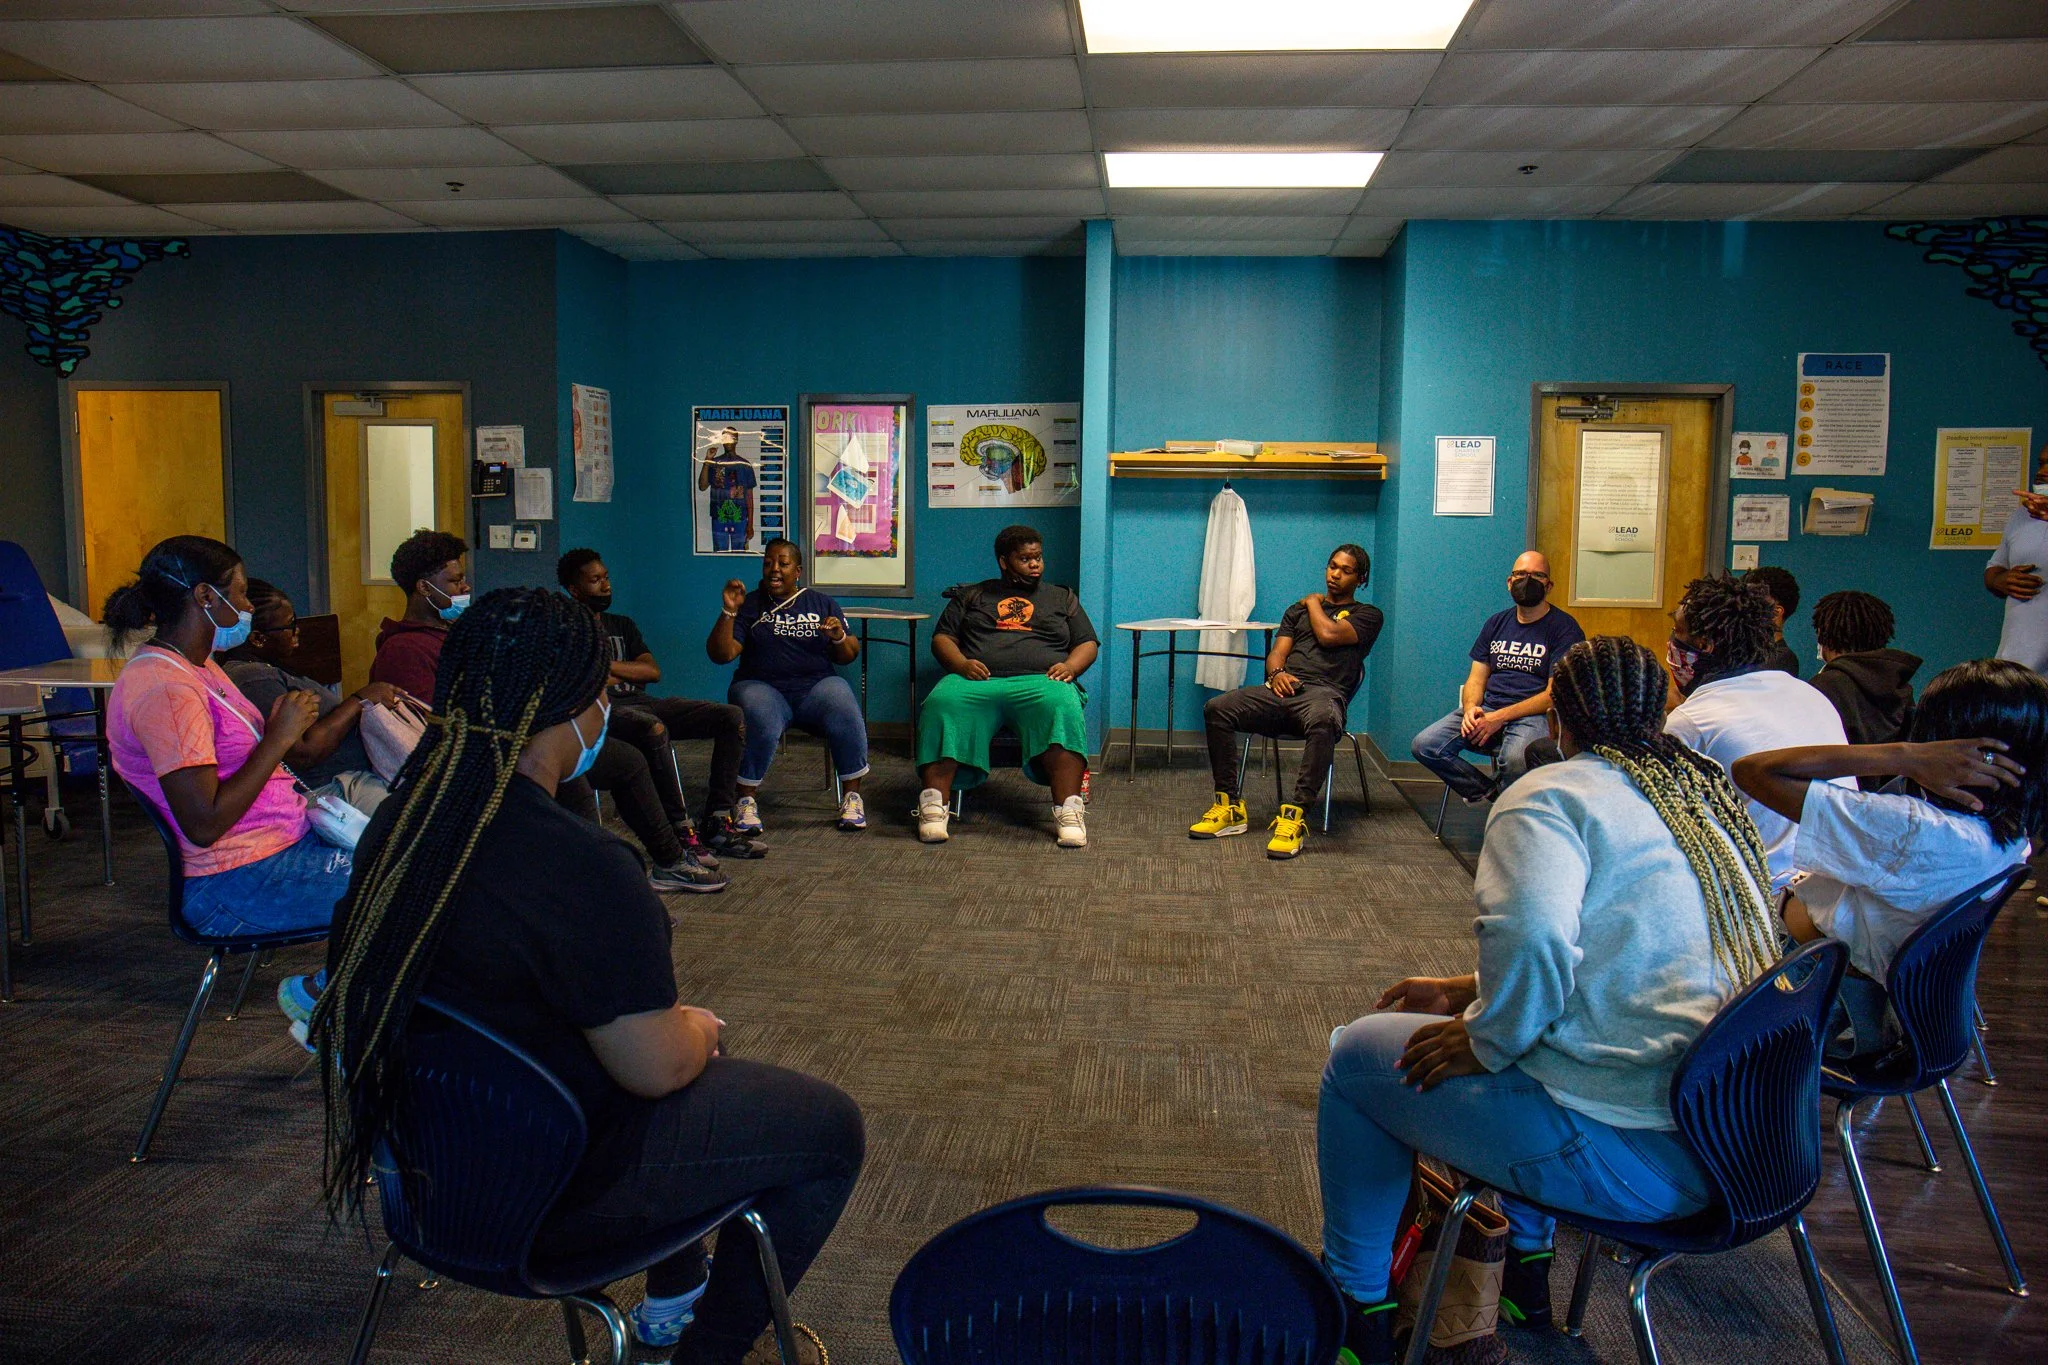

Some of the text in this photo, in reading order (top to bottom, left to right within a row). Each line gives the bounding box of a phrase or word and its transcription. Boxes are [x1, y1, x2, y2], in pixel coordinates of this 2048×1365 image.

[1825, 360, 1863, 370] RACE
[1804, 385, 1811, 394] R
[1803, 401, 1810, 409] A
[699, 408, 783, 420] MARIJUANA
[966, 408, 1040, 418] MARIJUANA
[1802, 420, 1809, 428] C
[1454, 440, 1482, 448] LEAD
[1801, 437, 1809, 447] E
[1799, 455, 1807, 464] S
[1615, 526, 1638, 534] LEAD
[1945, 528, 1973, 536] LEAD
[775, 612, 821, 625] LEAD
[774, 623, 821, 631] CHARTER
[774, 629, 818, 637] SCHOOL
[1499, 640, 1546, 658] LEAD
[1497, 654, 1542, 667] CHARTER
